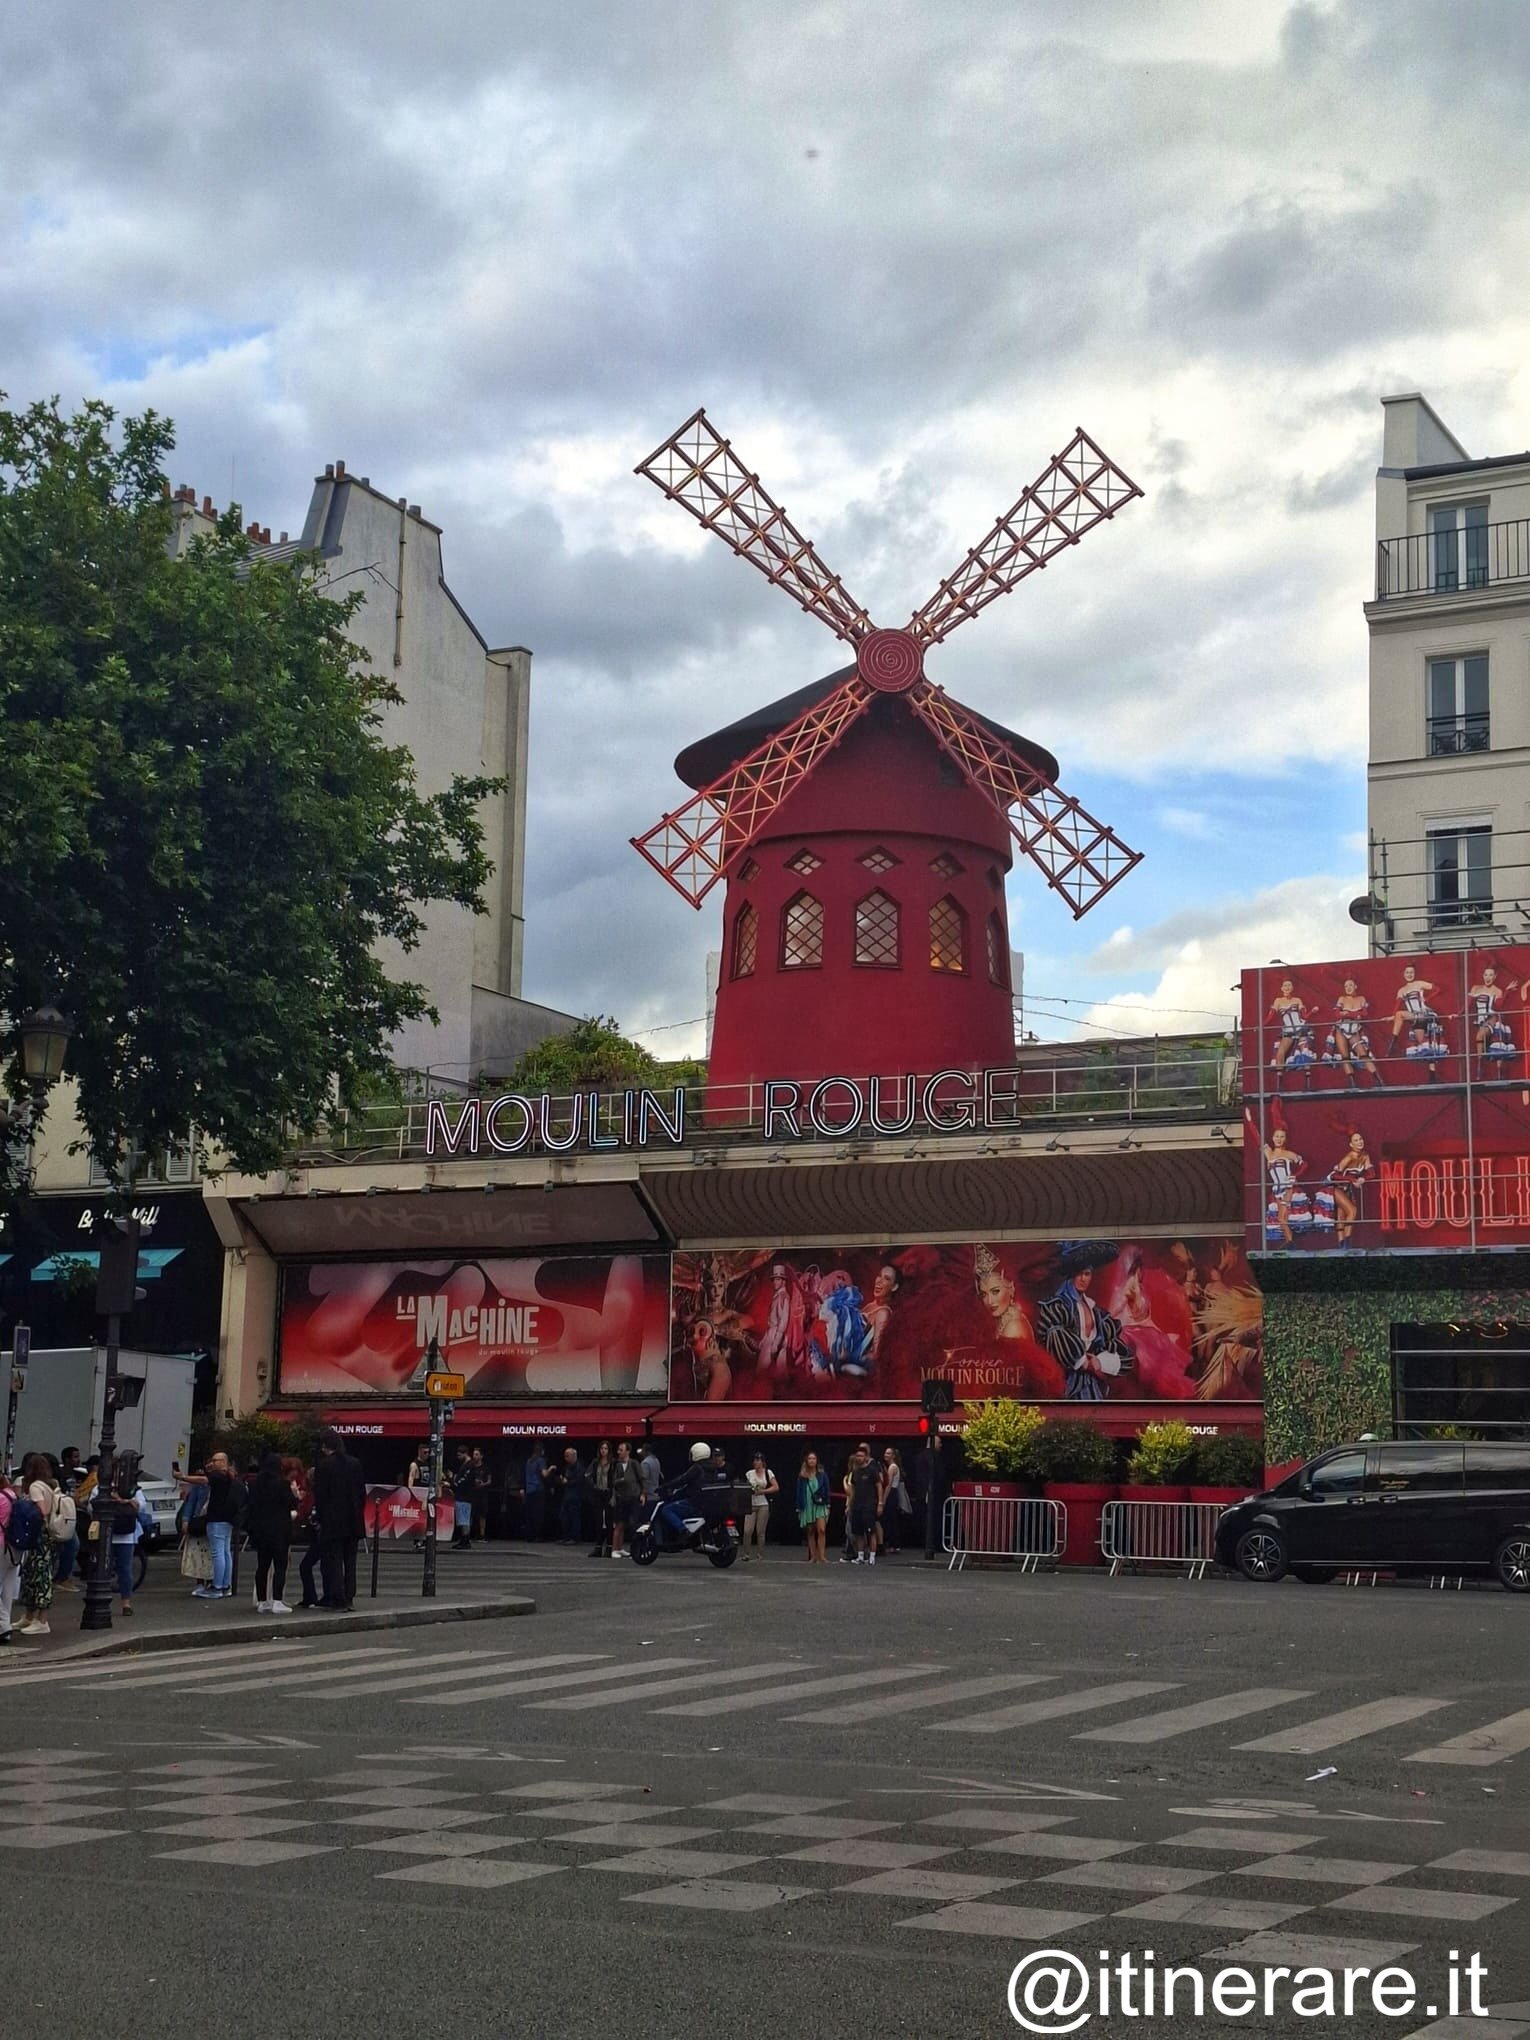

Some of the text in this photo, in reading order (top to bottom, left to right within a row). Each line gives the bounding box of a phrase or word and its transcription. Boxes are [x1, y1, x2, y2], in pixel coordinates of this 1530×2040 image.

[425, 1067, 1022, 1155] MOULIN ROUGE
[397, 1295, 416, 1314] LA
[936, 1346, 1004, 1370] Forever
[975, 1366, 1025, 1387] ROUGE
[329, 1425, 384, 1434] OULIN ROUGE
[502, 1425, 567, 1435] MOULIN ROUGE
[744, 1423, 807, 1432] MOULIN ROUGE
